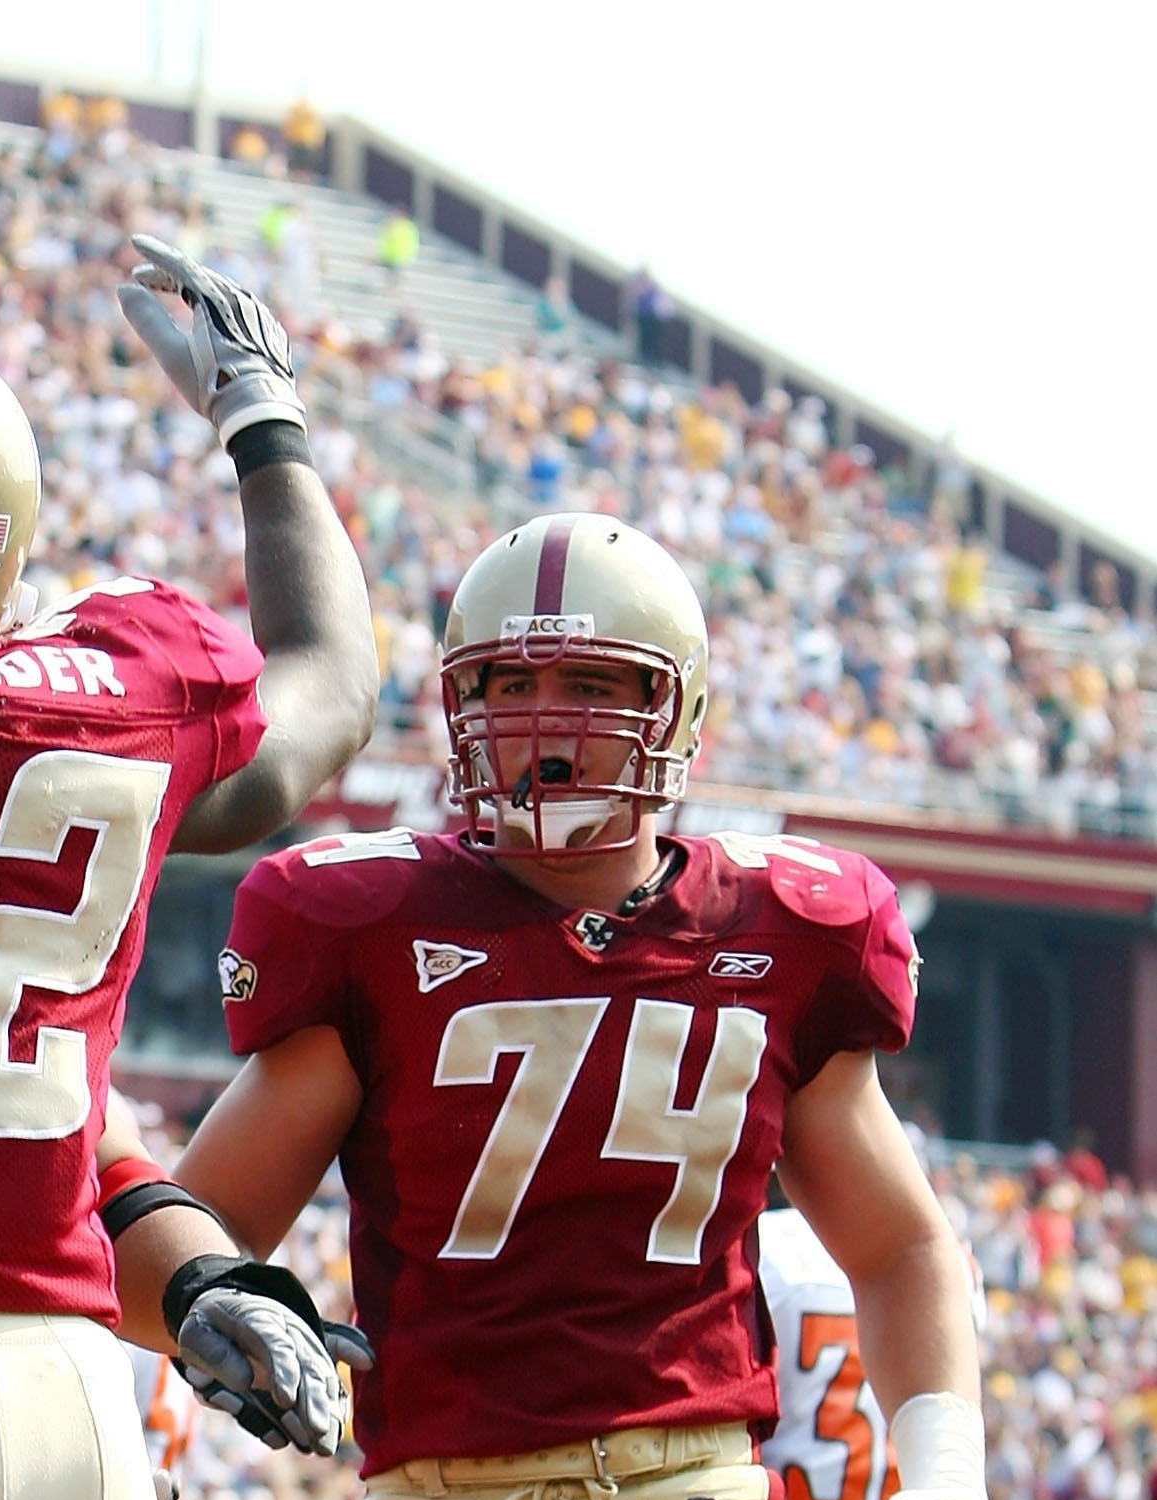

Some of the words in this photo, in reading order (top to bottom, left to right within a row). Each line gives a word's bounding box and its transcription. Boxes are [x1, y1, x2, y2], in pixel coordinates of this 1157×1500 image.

[526, 617, 567, 634] ACC
[430, 959, 454, 970] ACC
[432, 996, 768, 1265] 74
